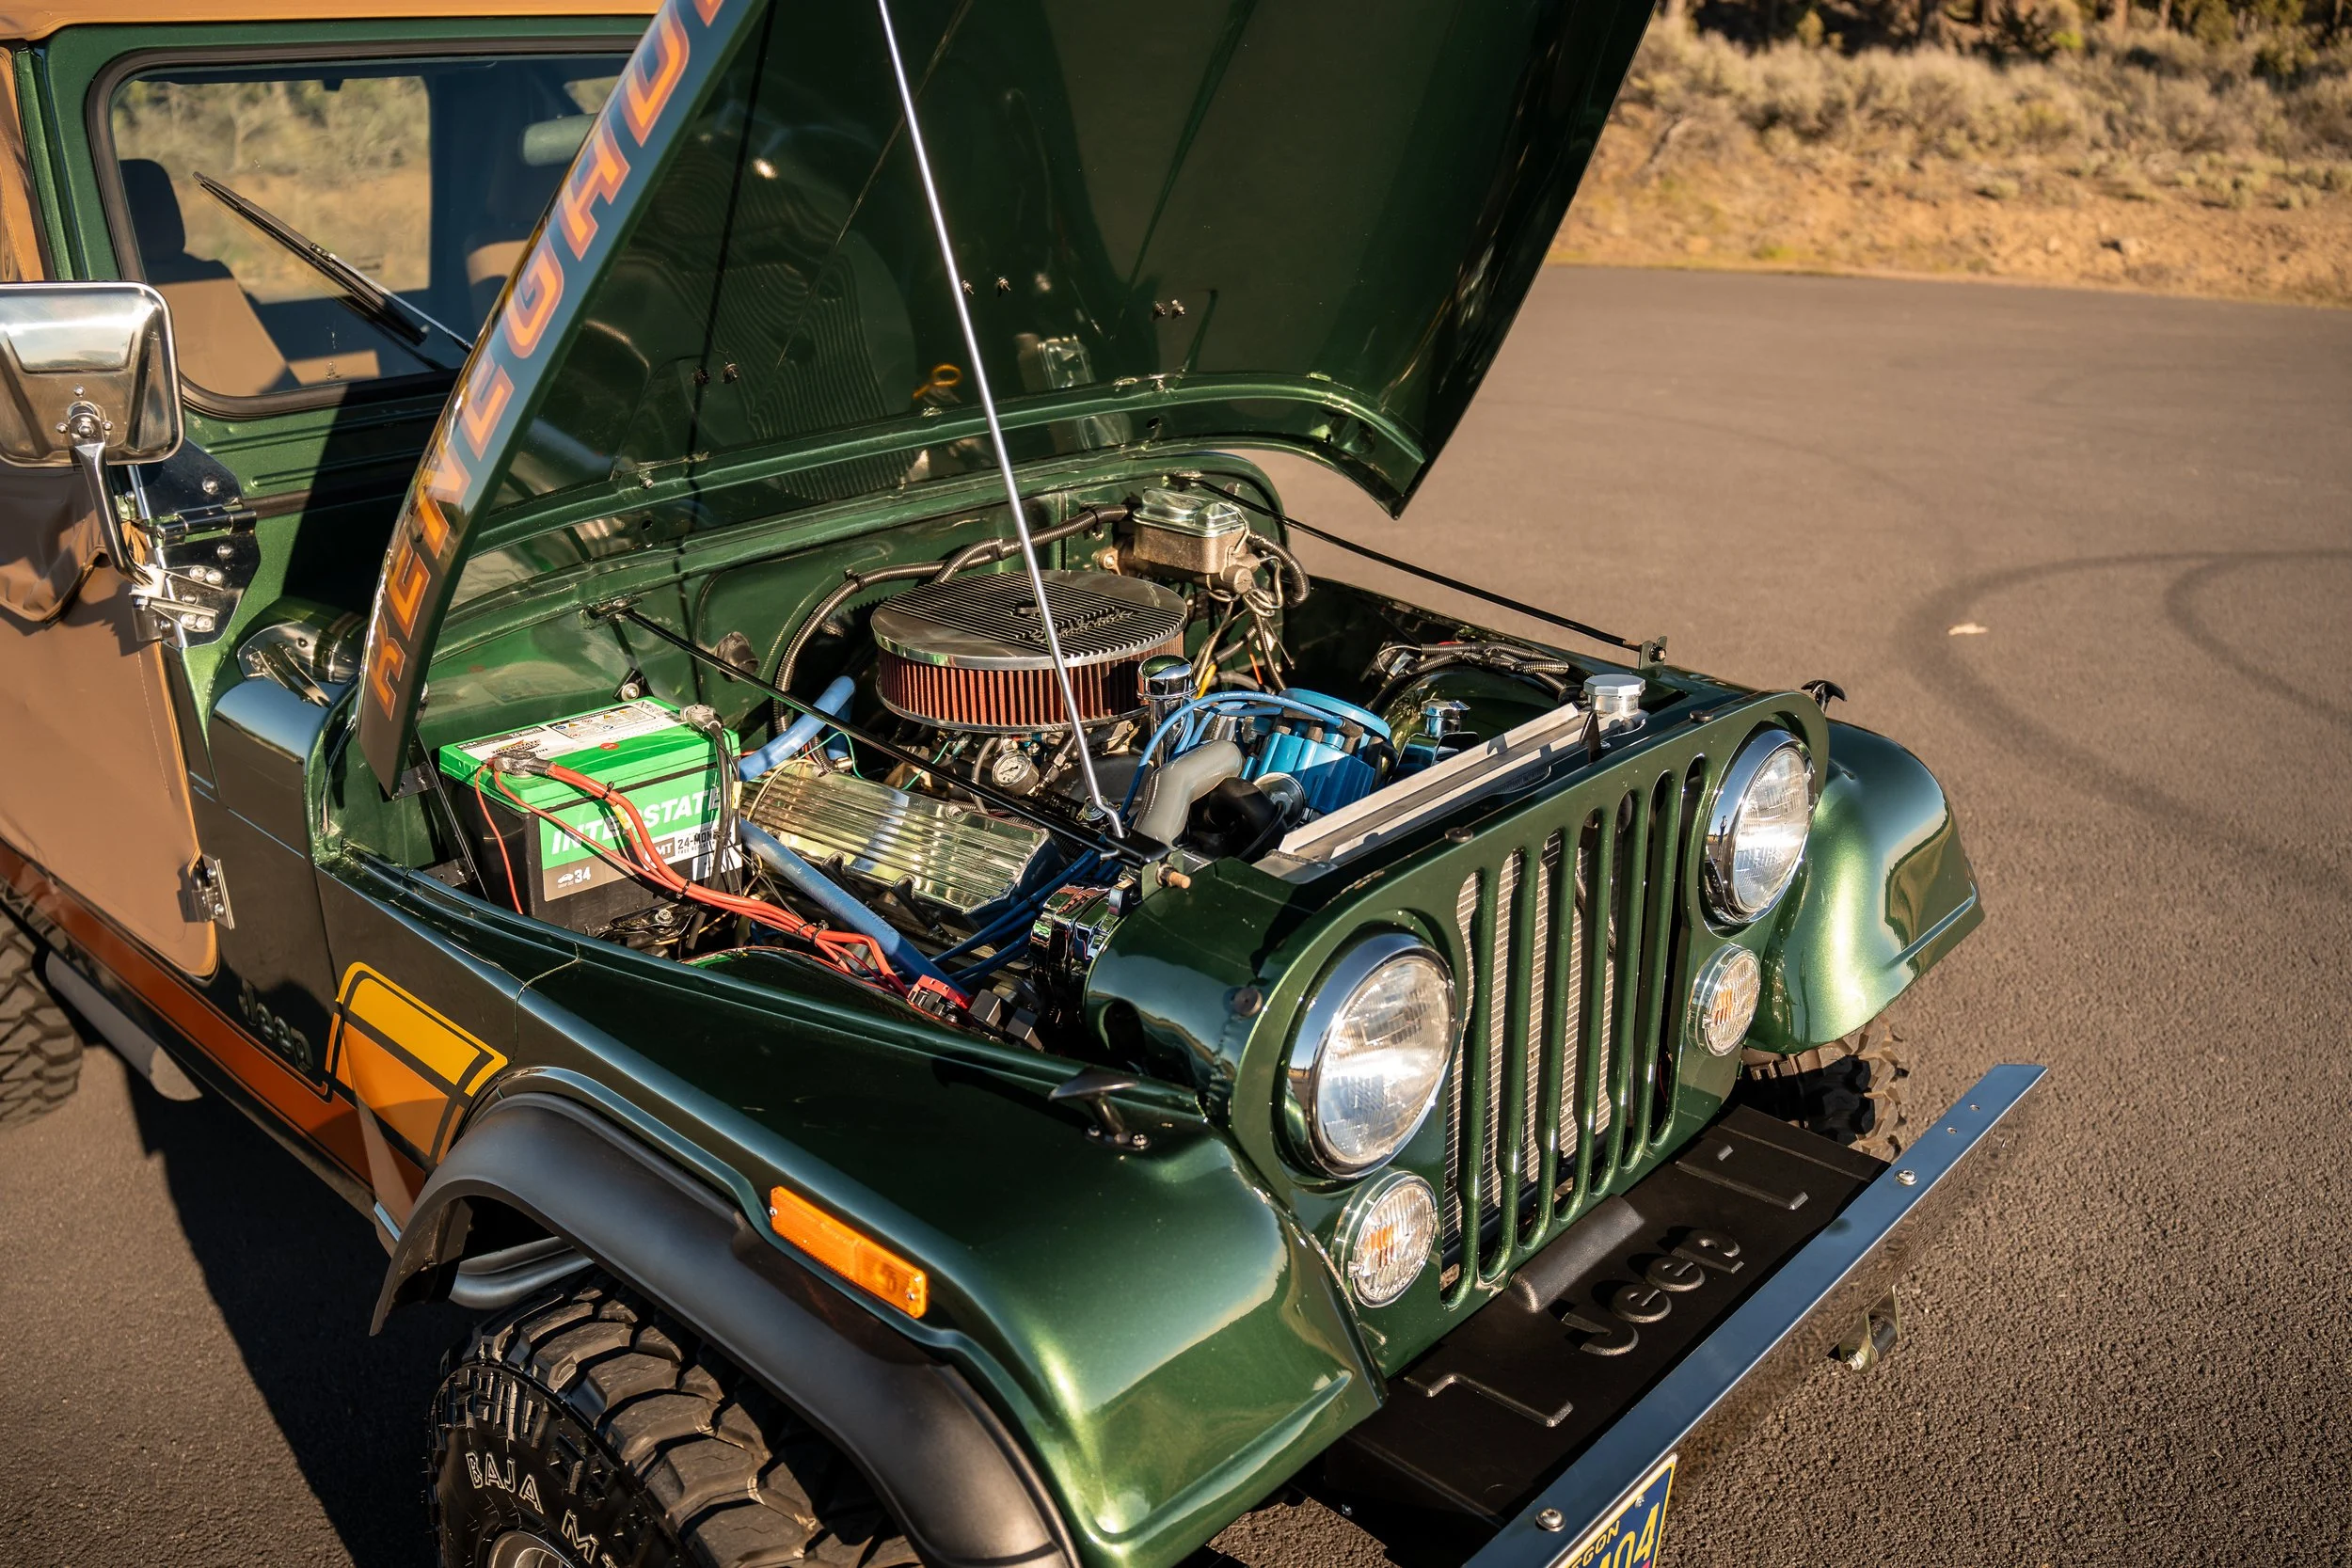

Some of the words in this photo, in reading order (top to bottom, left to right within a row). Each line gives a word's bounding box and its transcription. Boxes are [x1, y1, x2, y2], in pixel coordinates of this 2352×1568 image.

[365, 0, 724, 721] RENEGAD
[1029, 610, 1134, 645] Eelbrock
[677, 830, 717, 850] 24-MON
[574, 865, 592, 884] 34
[238, 978, 313, 1074] Jeep
[1562, 1229, 1744, 1356] Jeep
[466, 1451, 545, 1514] BAJA
[1599, 1502, 1660, 1568] 04
